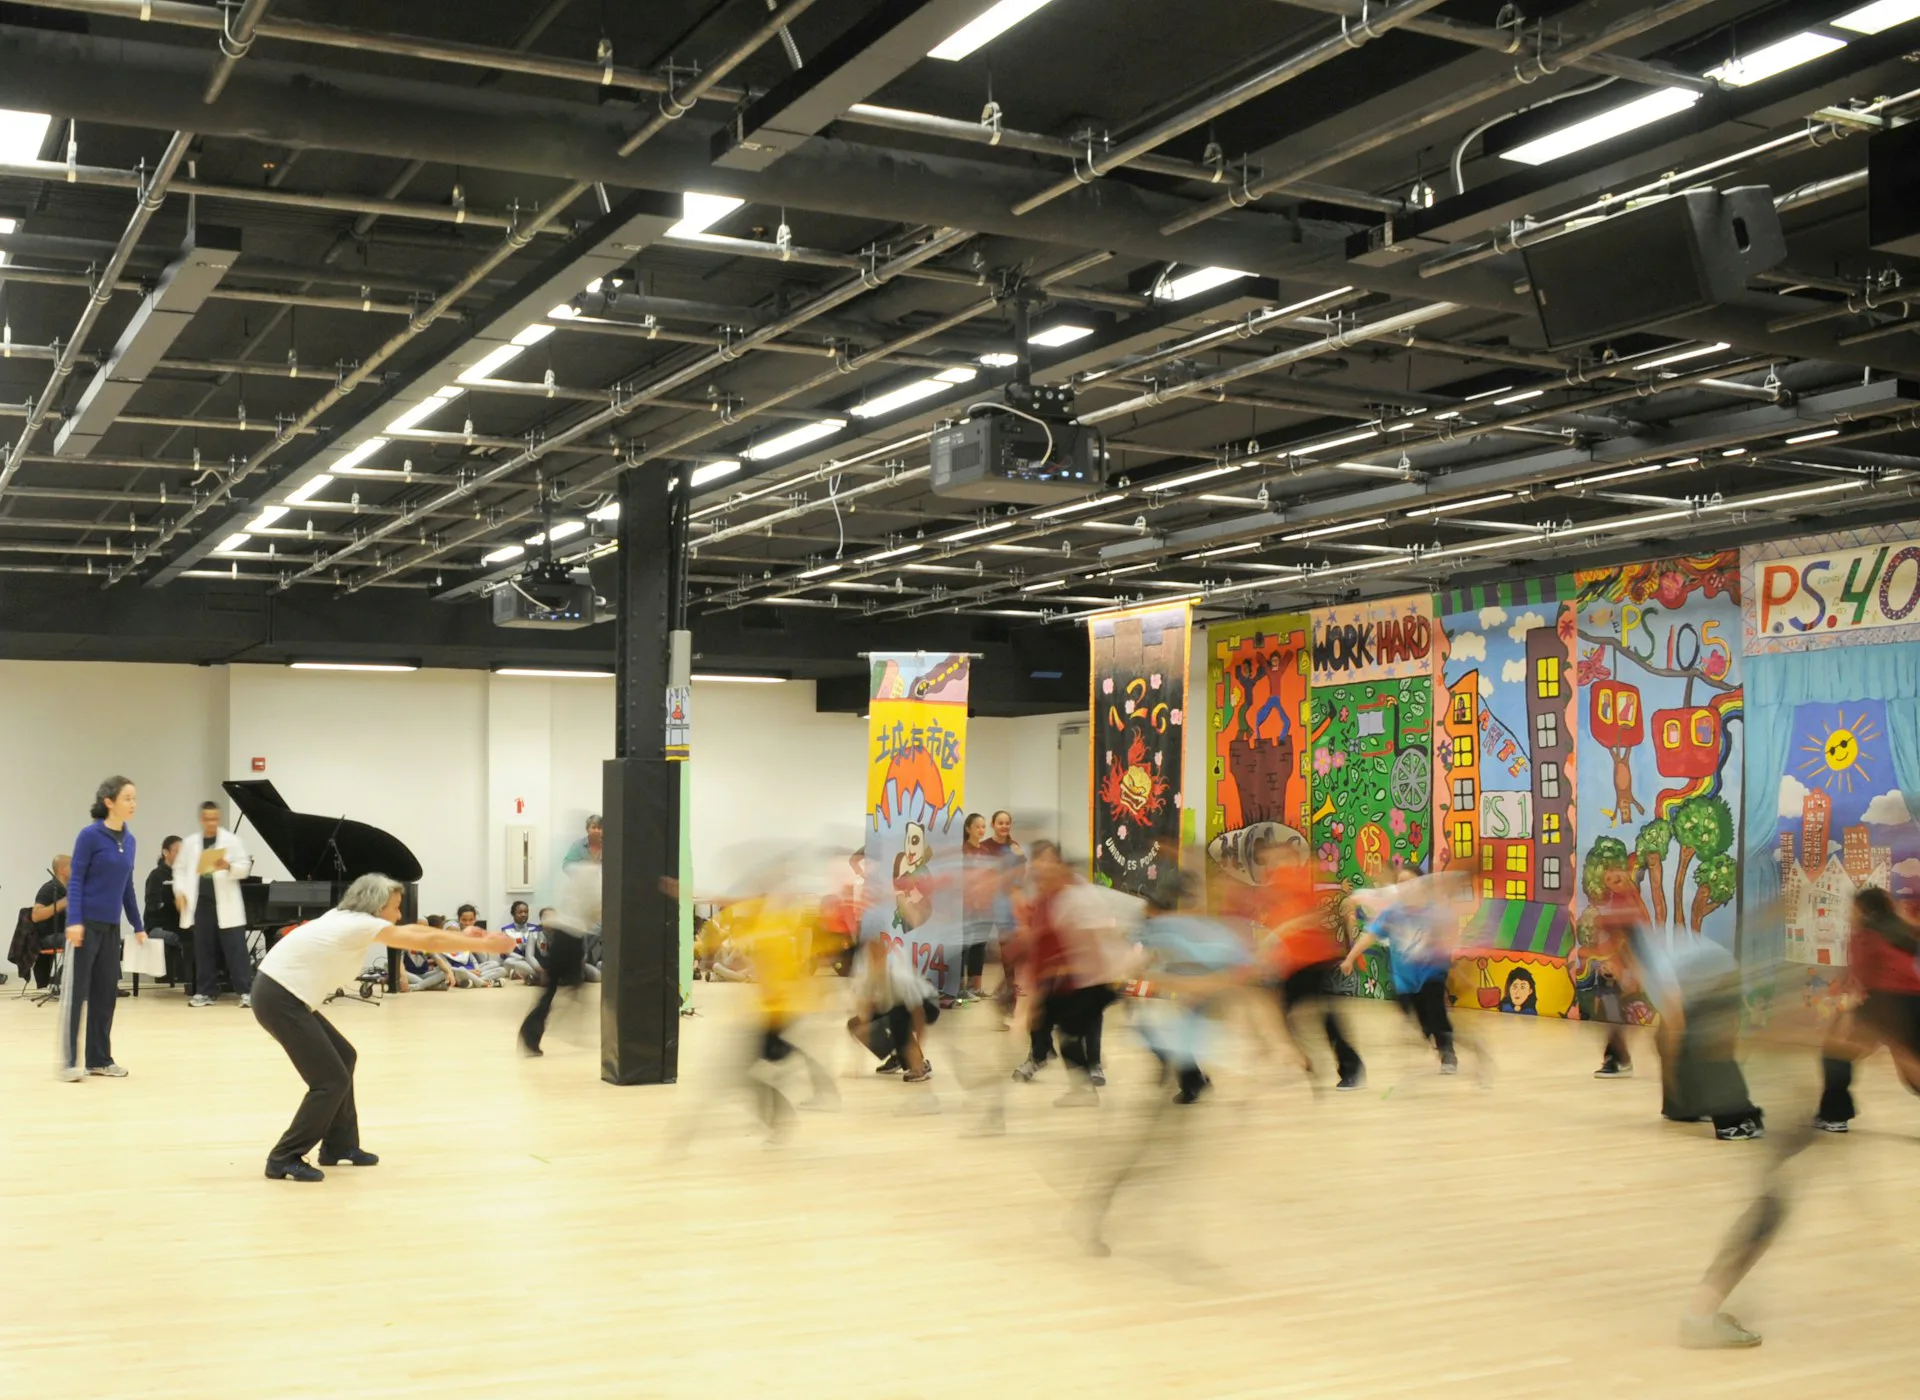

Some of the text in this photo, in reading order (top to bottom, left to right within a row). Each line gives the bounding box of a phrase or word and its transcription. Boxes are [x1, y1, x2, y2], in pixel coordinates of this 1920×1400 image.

[1313, 615, 1431, 672] WORK HARD
[1621, 604, 1732, 681] PS 105
[1482, 793, 1530, 838] PS 1
[1127, 860, 1137, 870] ES
[1140, 841, 1161, 868] PODER
[1360, 825, 1380, 852] PS
[1363, 852, 1382, 876] 199
[911, 941, 949, 990] 124
